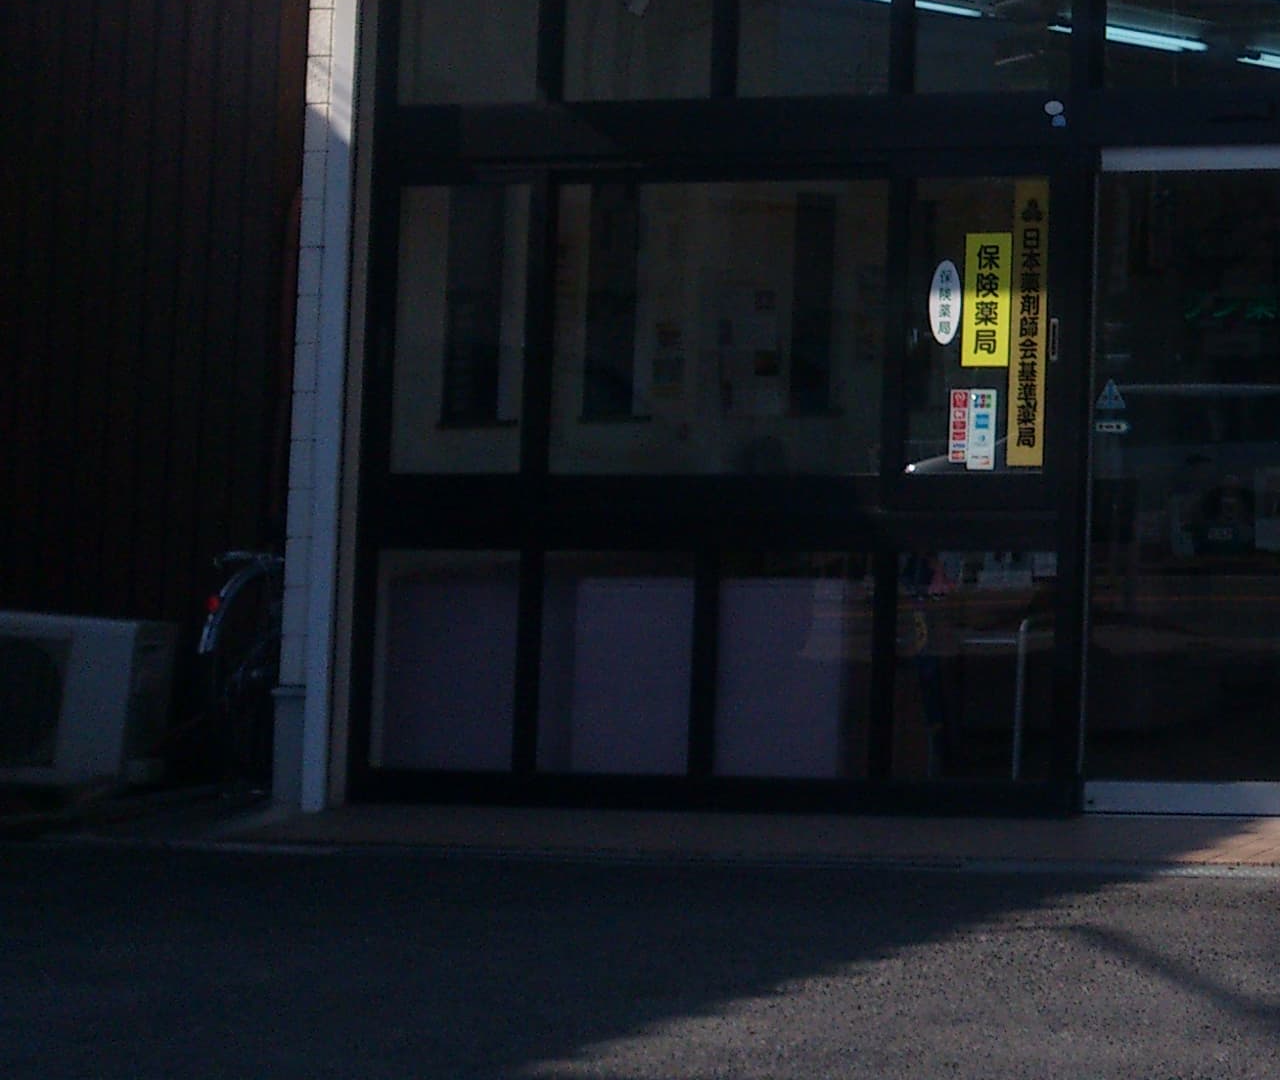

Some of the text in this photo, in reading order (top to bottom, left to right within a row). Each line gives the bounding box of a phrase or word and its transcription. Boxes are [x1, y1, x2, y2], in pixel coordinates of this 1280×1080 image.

[973, 244, 1000, 355] 保険薬局
[1015, 228, 1041, 449] 日本薬剤師会基準薬局
